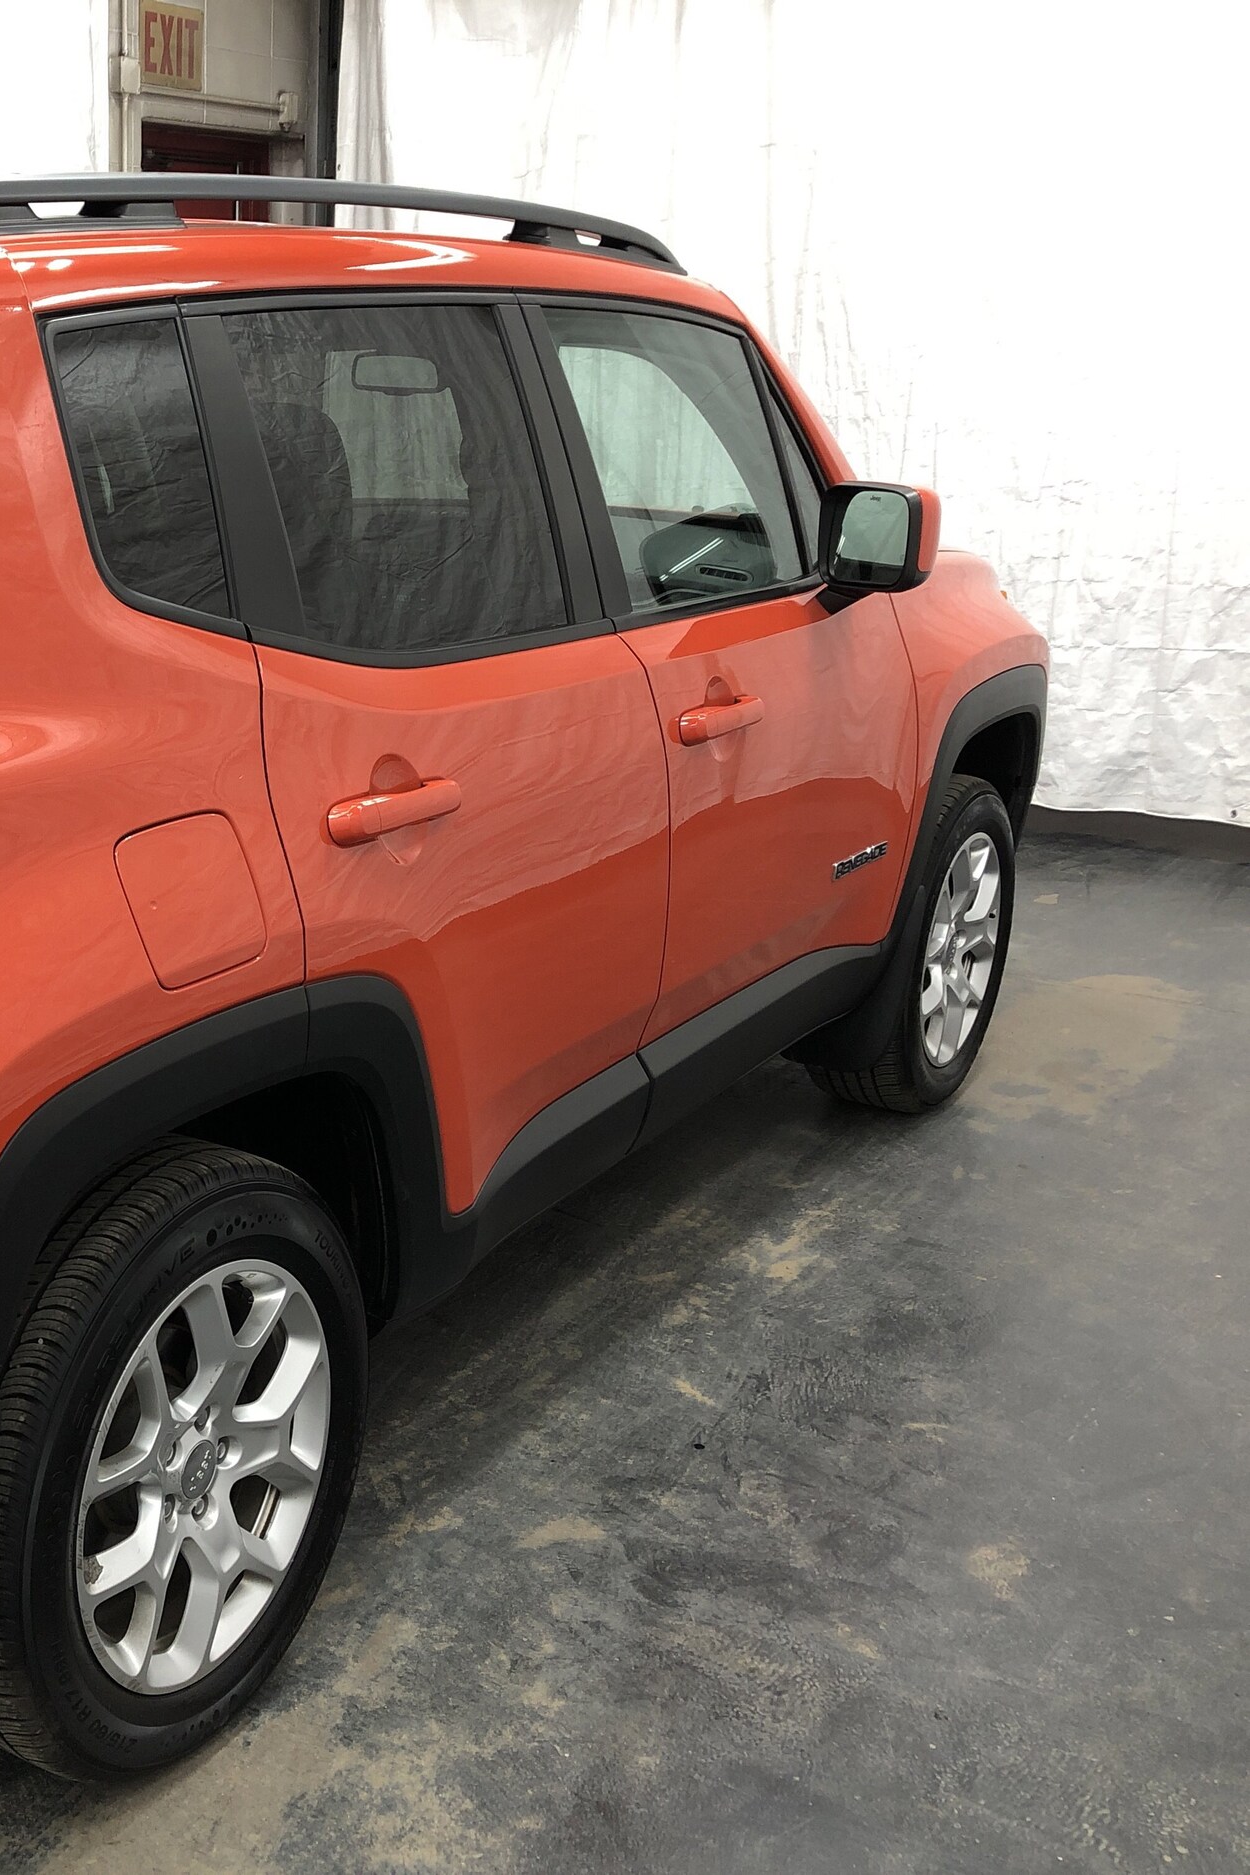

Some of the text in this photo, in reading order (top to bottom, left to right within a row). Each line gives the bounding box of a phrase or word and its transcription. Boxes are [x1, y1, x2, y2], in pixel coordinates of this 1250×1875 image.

[144, 11, 199, 79] EXIT
[832, 841, 888, 881] RENEGADE
[315, 1228, 350, 1290] TOURING
